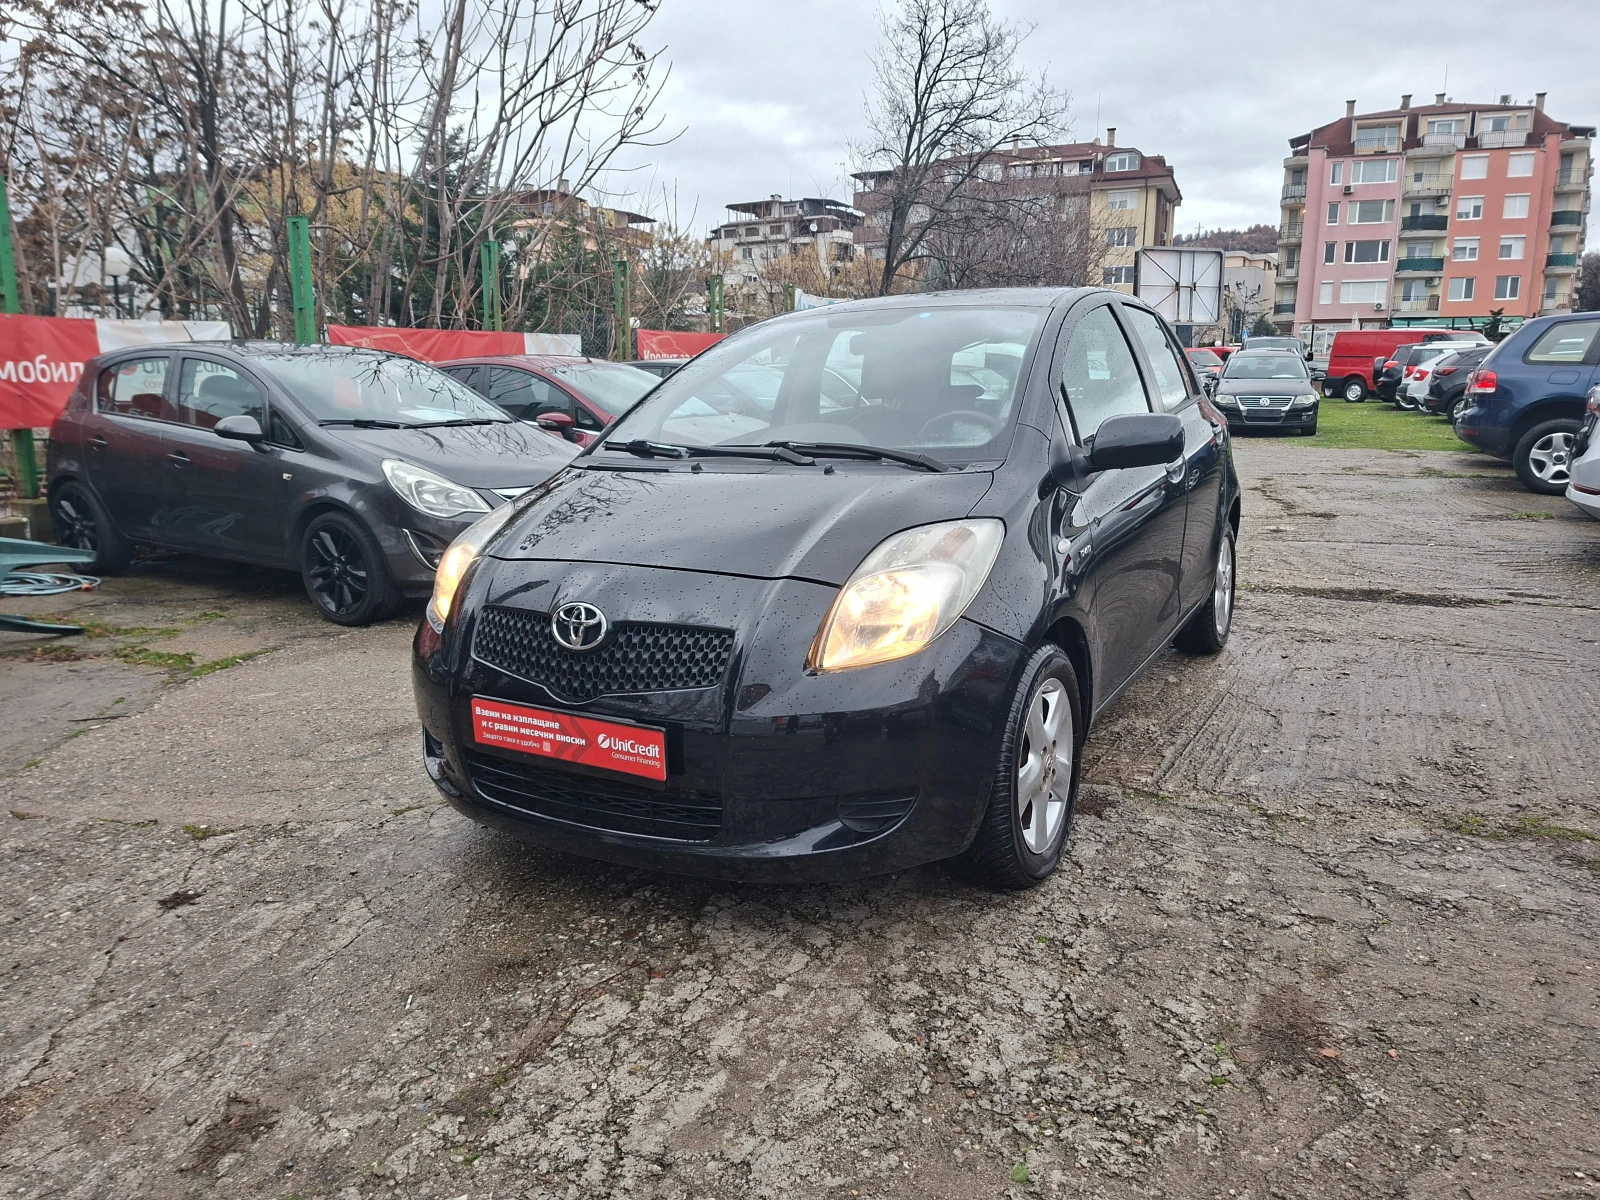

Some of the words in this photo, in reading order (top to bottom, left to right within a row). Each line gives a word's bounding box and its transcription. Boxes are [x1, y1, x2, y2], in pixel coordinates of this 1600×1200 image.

[475, 706, 500, 719] Вземи
[501, 712, 512, 720] на
[513, 714, 560, 730] изплащане
[494, 722, 518, 733] равни
[520, 727, 554, 740] месечни
[555, 734, 586, 746] вноски
[611, 736, 660, 758] UniCredit
[611, 751, 636, 762] Consumer
[636, 756, 661, 768] Financing
